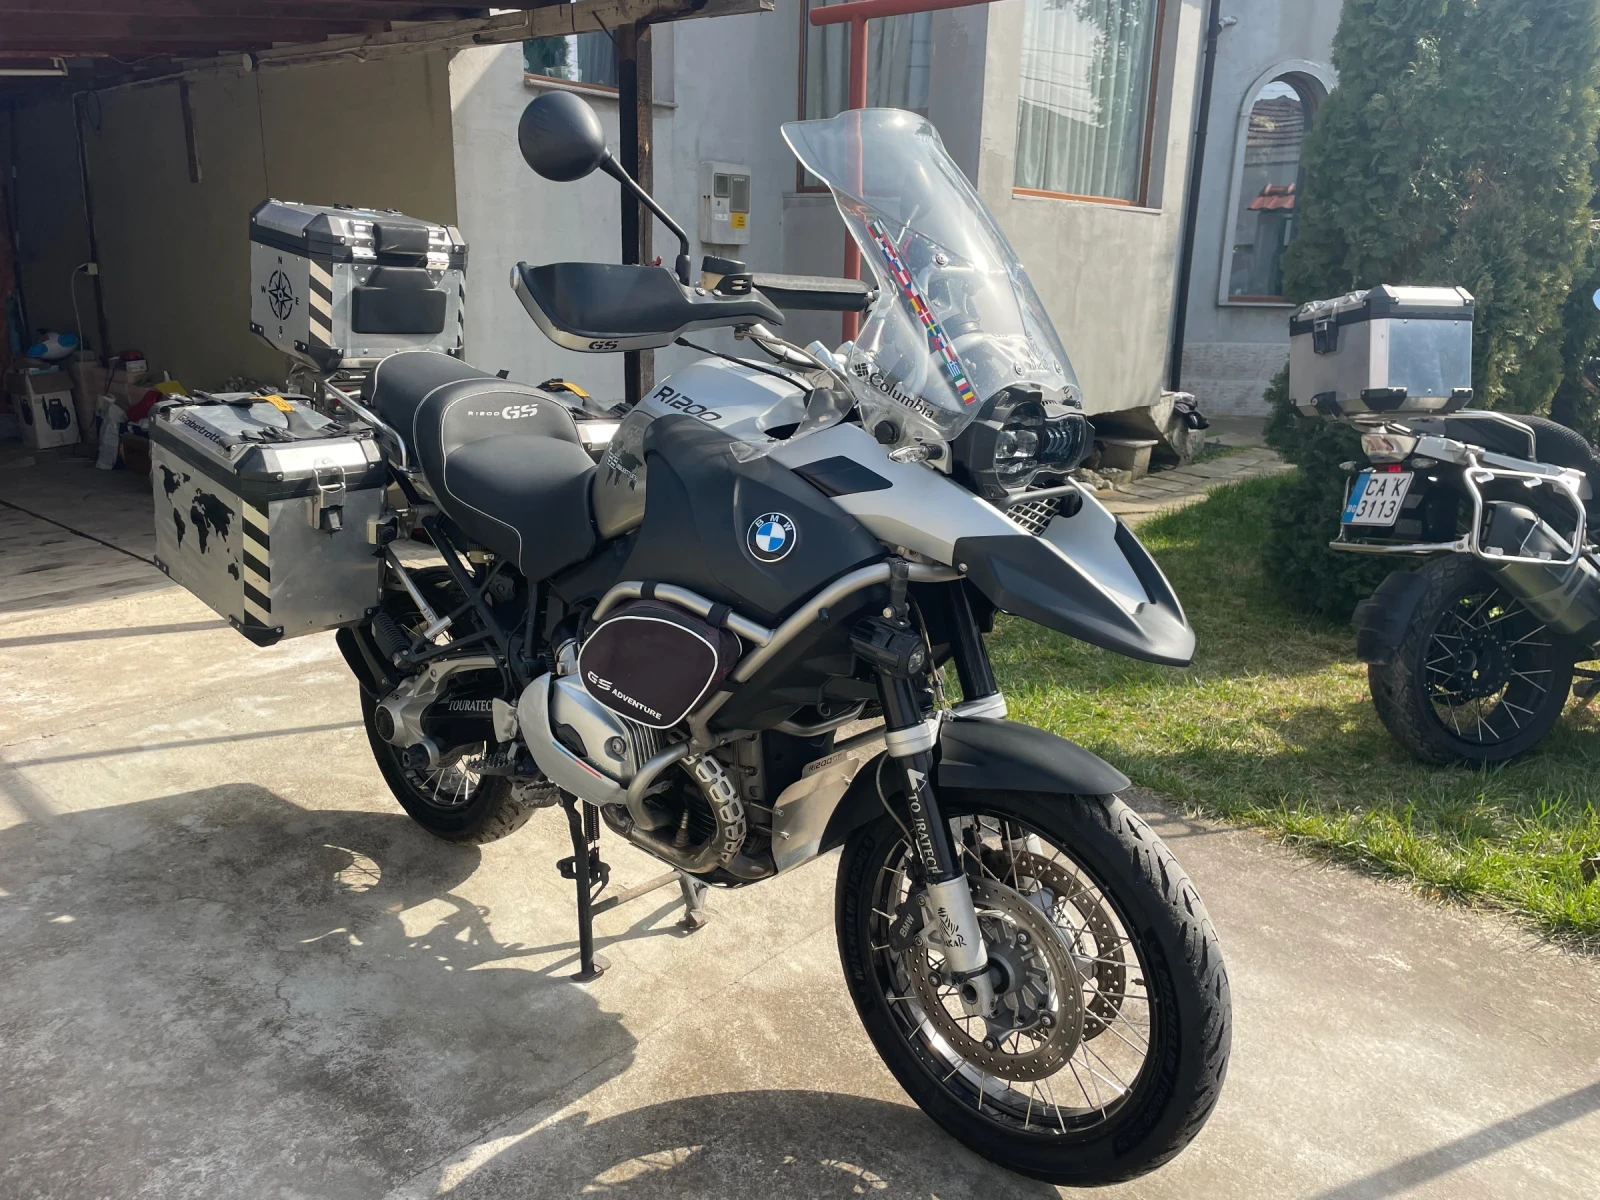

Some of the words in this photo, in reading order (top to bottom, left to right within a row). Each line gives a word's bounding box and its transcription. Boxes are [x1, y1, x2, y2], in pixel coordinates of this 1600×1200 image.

[278, 256, 282, 264] N
[260, 285, 266, 294] W
[295, 296, 300, 306] E
[278, 326, 282, 334] S
[588, 340, 620, 350] GS
[653, 385, 722, 422] R1200
[869, 372, 935, 419] Columbia
[502, 404, 539, 420] GS
[1366, 478, 1388, 496] CA
[1392, 478, 1406, 496] K
[1346, 504, 1357, 512] BG
[1356, 500, 1396, 518] 3113
[755, 514, 792, 532] BMW
[587, 670, 613, 691] GS
[612, 688, 662, 720] ADVENTURE
[448, 700, 492, 712] TOURATEC
[900, 912, 916, 938] BMW
